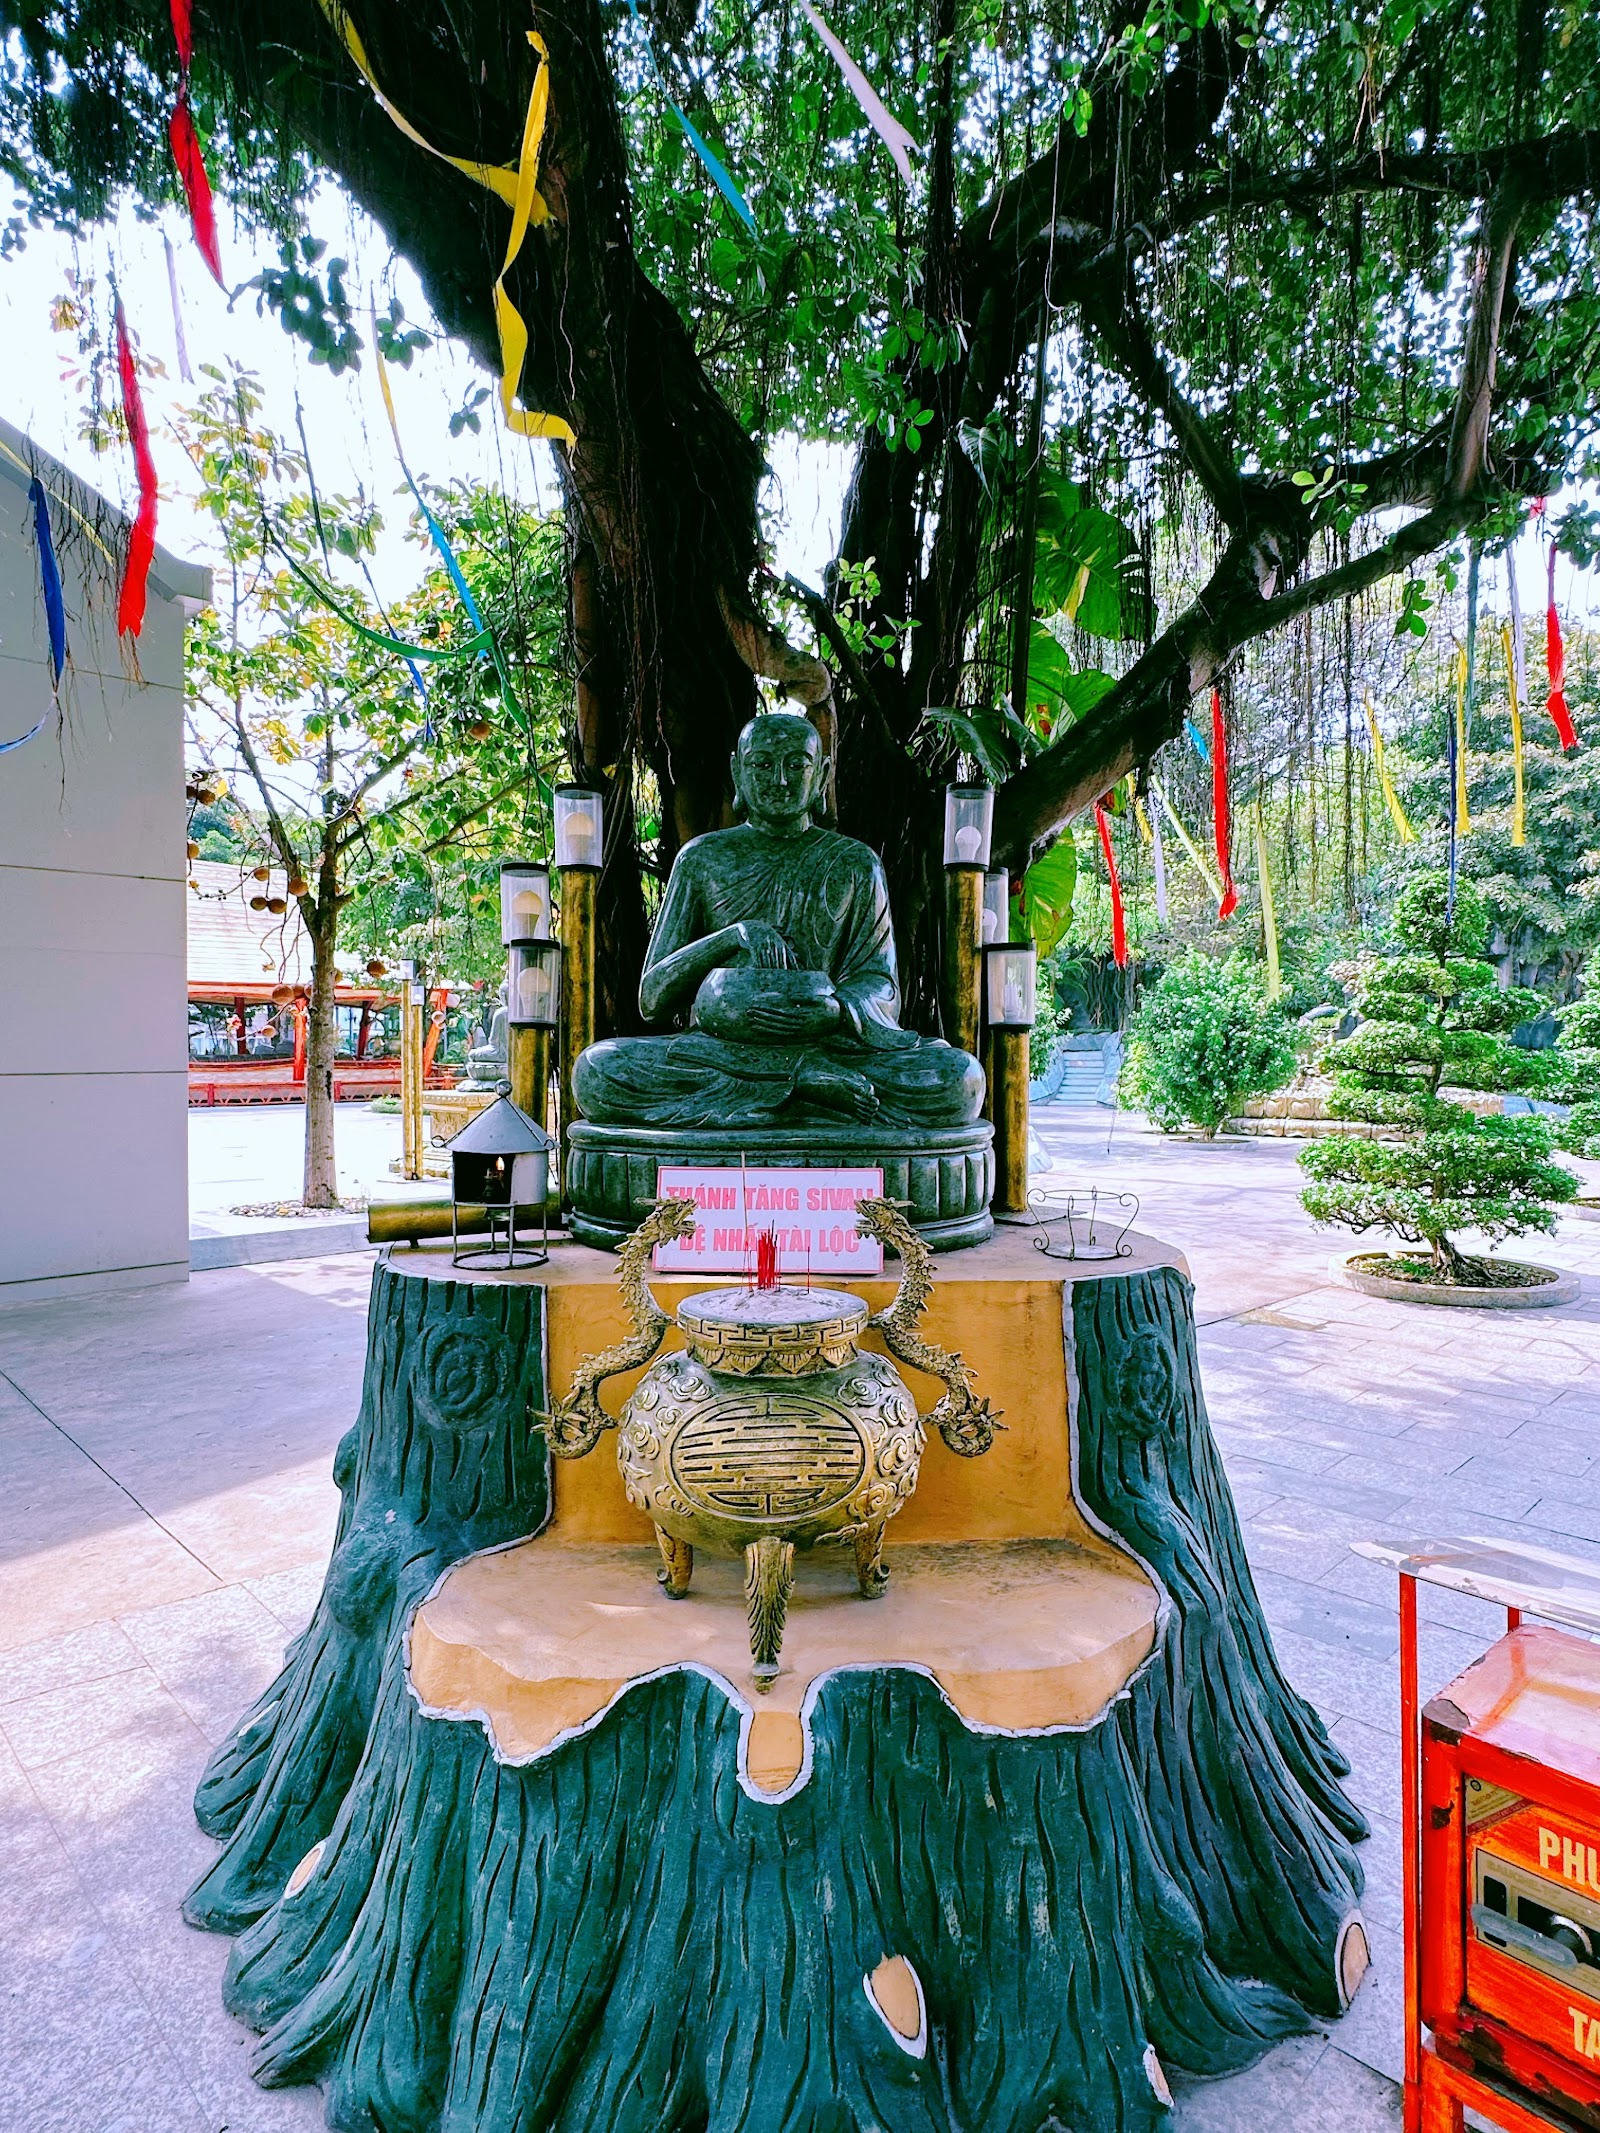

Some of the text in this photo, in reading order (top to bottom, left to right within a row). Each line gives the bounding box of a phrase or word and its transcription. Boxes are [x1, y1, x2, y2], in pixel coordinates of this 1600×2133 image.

[744, 1184, 799, 1211] TĂNG
[713, 1222, 772, 1252] NHẤ
[777, 1225, 811, 1252] TÀI
[819, 1225, 859, 1257] LỘC
